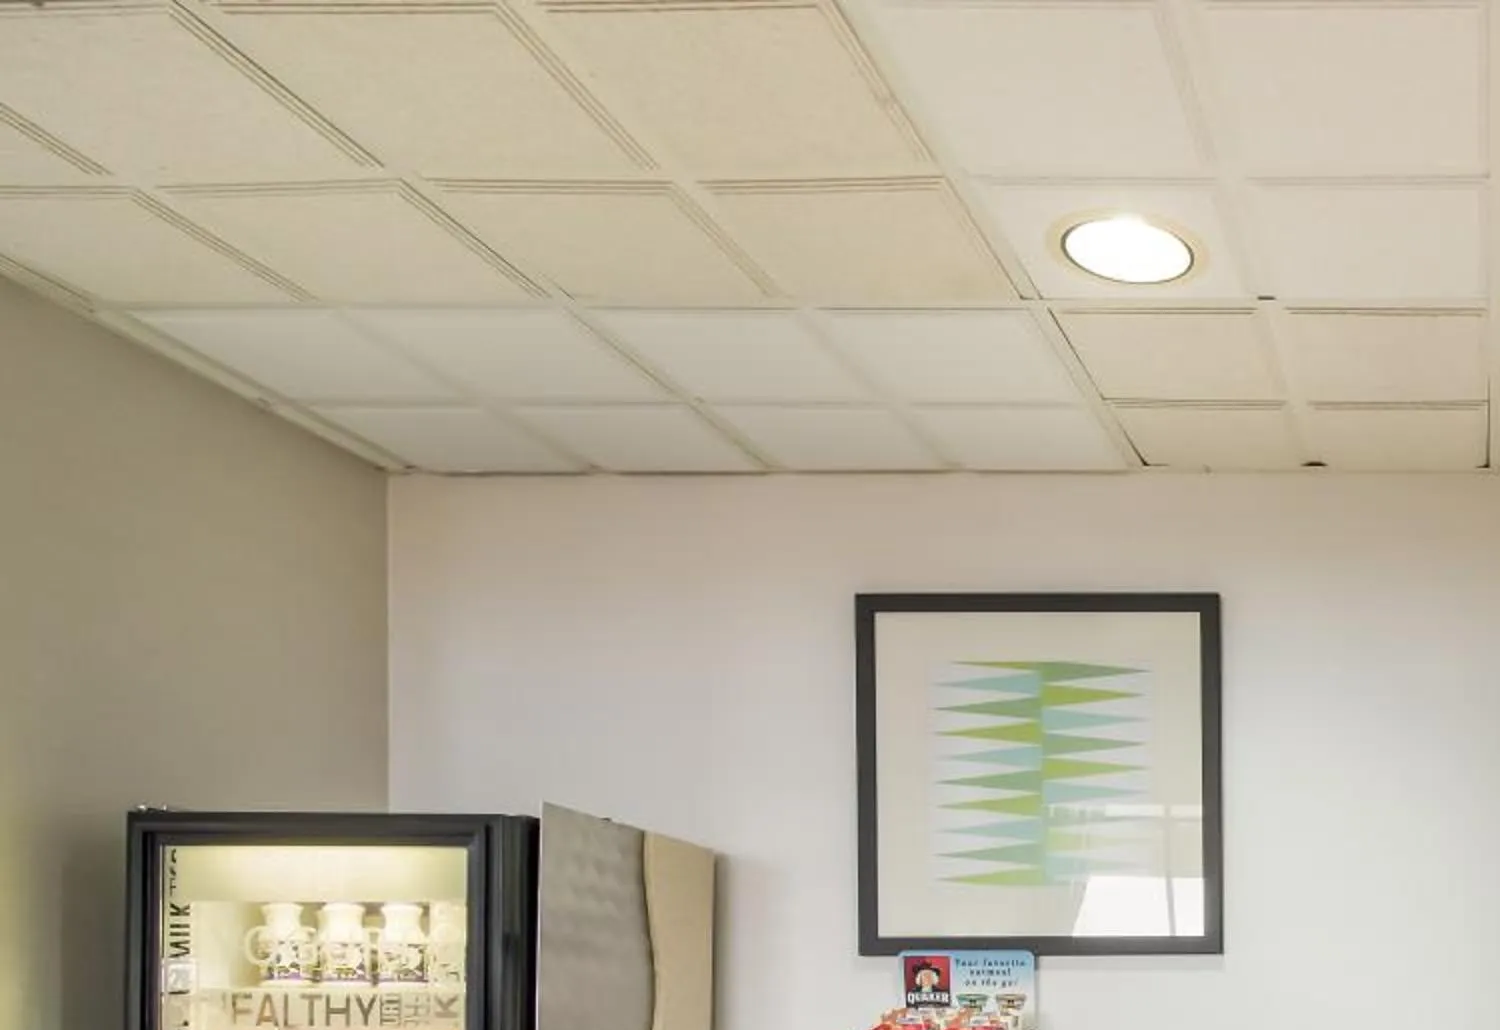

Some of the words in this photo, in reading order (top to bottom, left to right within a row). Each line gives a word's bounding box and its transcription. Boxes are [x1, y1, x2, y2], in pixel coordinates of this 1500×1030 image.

[955, 958, 979, 967] Your
[907, 992, 949, 1004] QUAKER
[222, 992, 378, 1029] EALTHY
